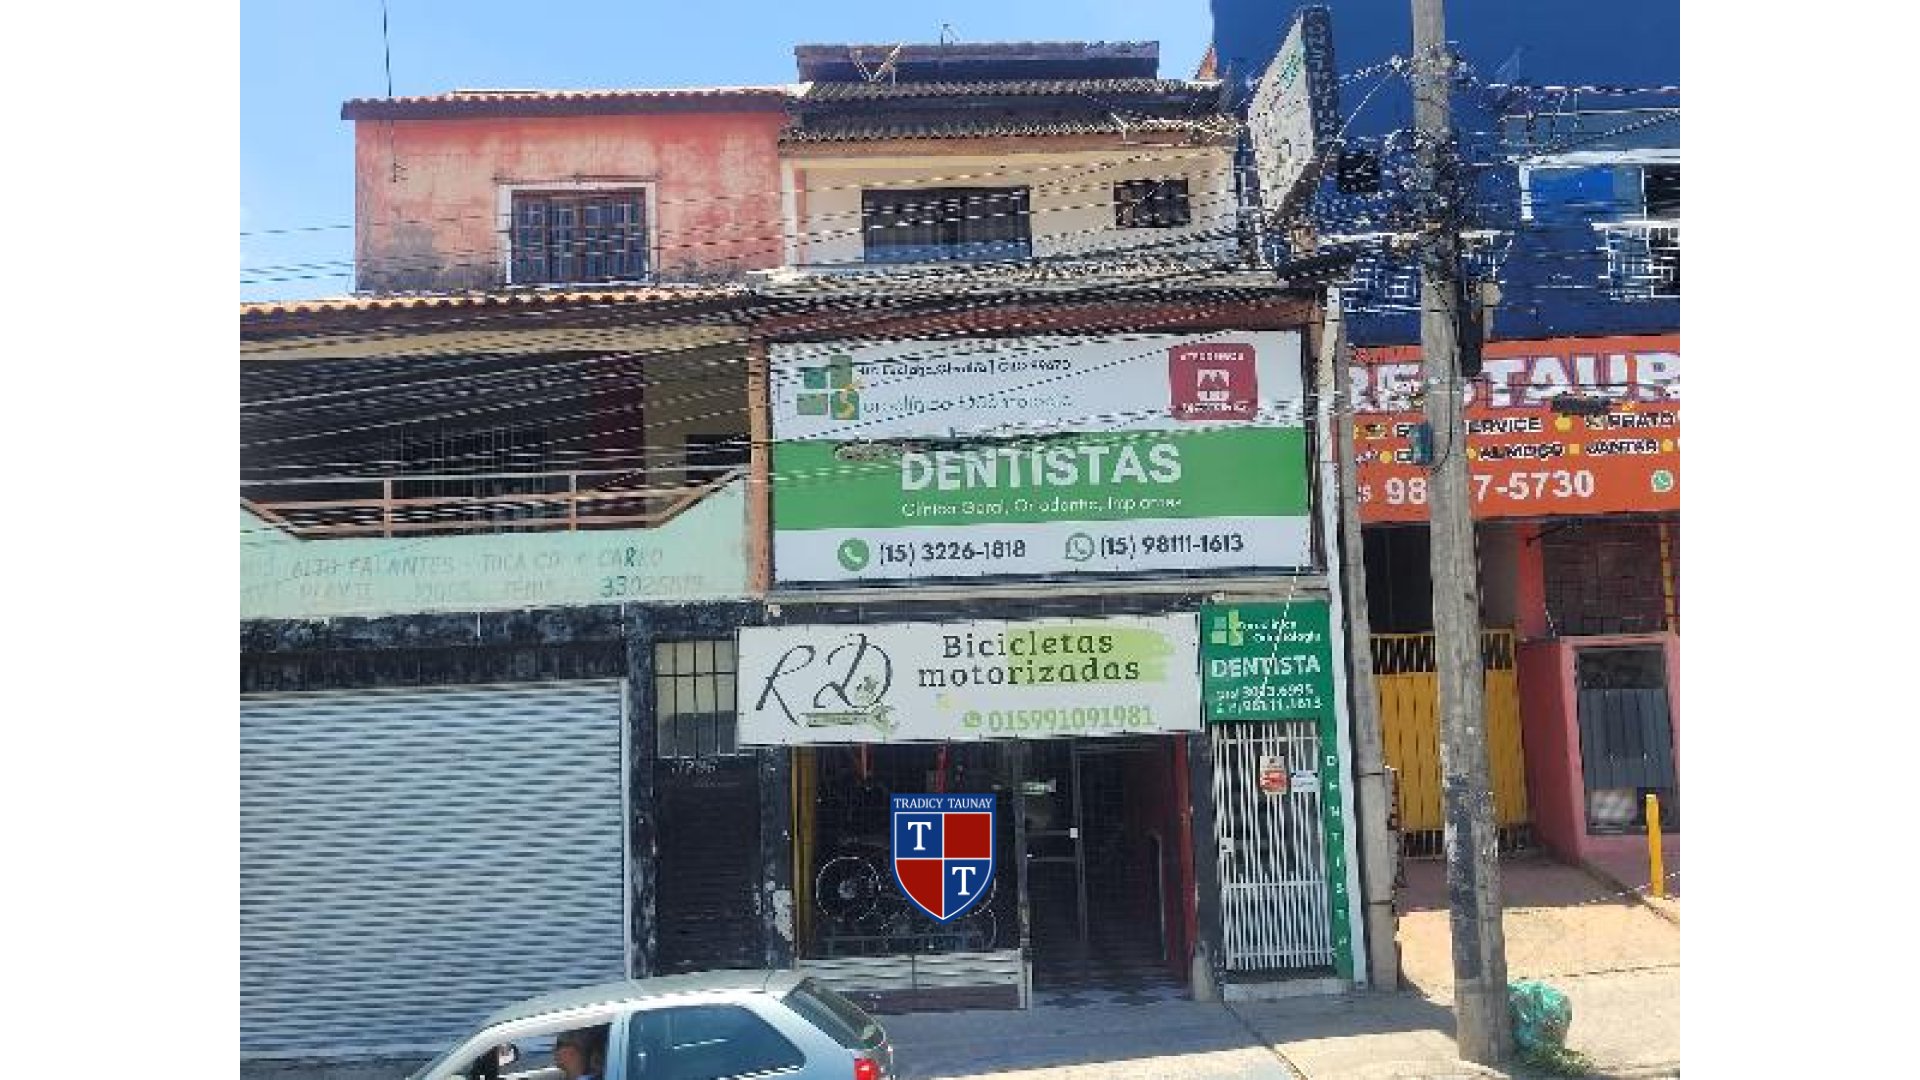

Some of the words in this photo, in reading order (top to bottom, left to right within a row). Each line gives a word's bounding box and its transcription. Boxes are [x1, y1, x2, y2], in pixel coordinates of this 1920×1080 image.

[1464, 416, 1543, 436] ERVICE
[901, 442, 1183, 492] DENTISTAS
[1385, 468, 1595, 506] 987-5730
[879, 543, 915, 567] (15)
[922, 540, 1027, 561] 3226-1818
[1101, 536, 1136, 559] (15)
[1141, 533, 1245, 555] 98111-1613
[943, 632, 1114, 659] Bicicletas
[918, 658, 1140, 688] motorizadas
[1210, 655, 1321, 678] DENTISTA
